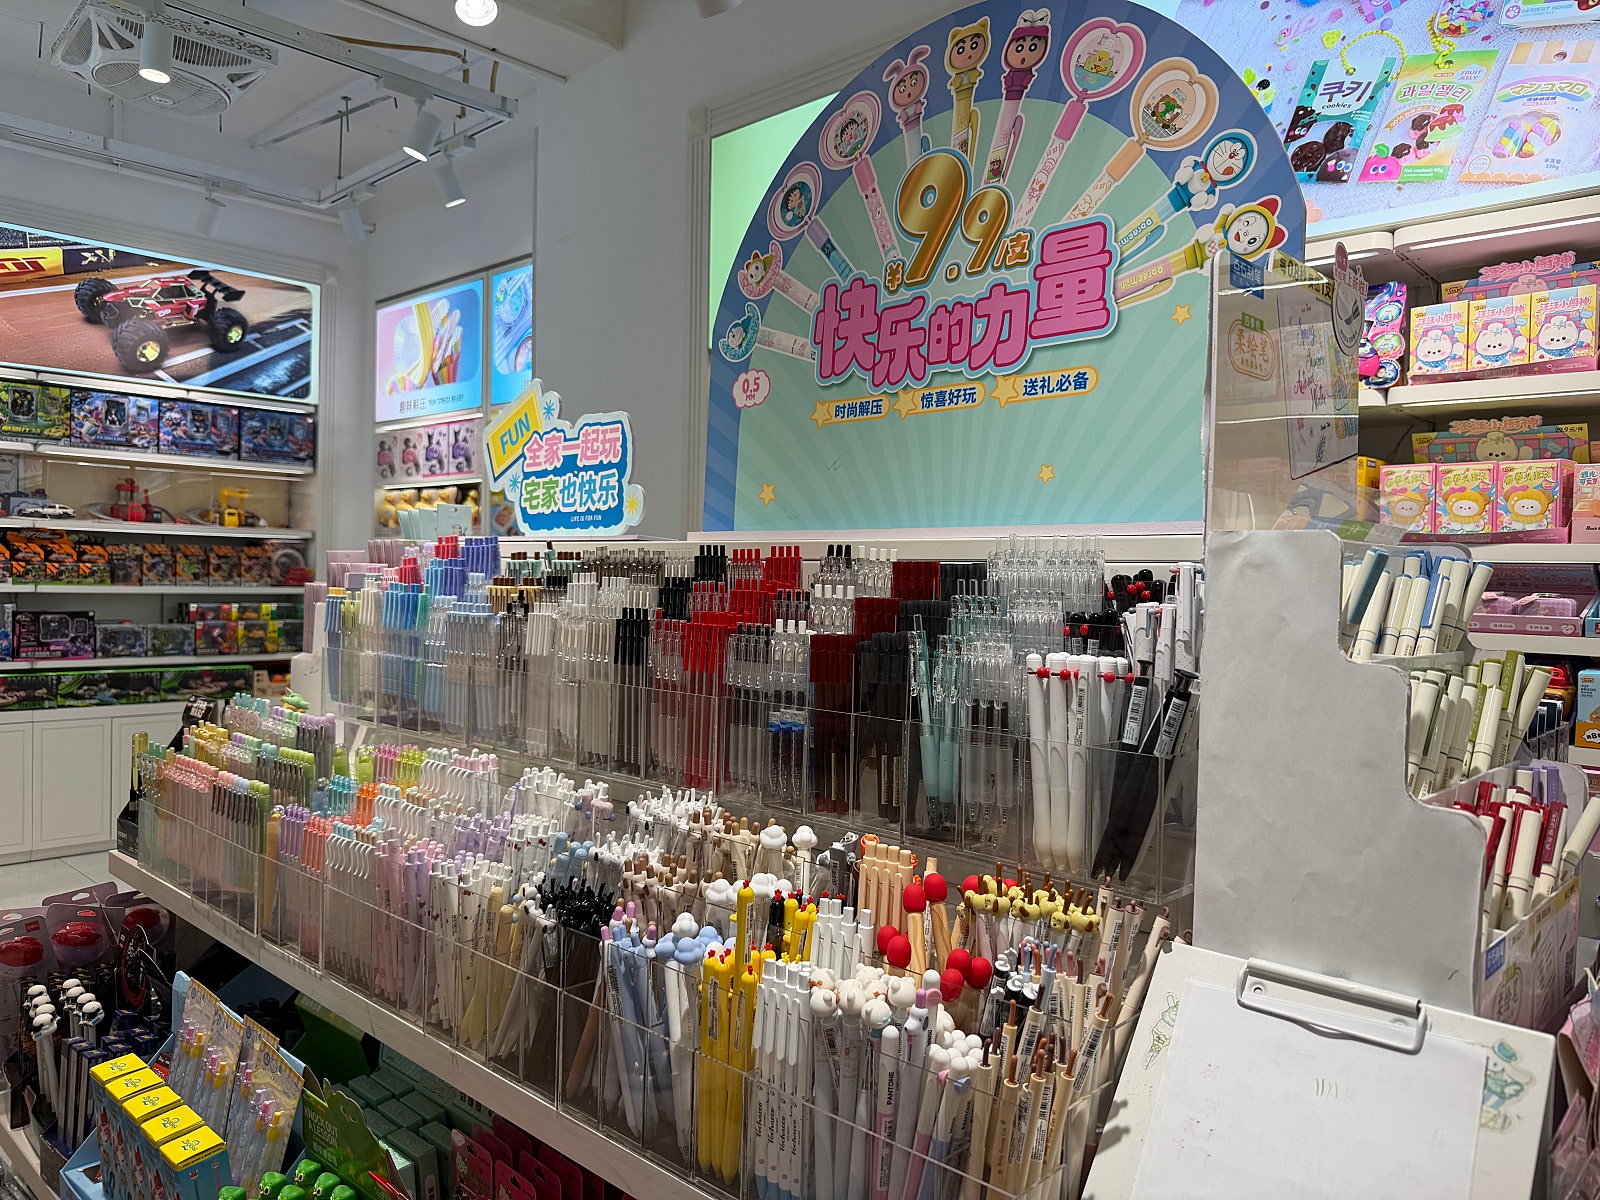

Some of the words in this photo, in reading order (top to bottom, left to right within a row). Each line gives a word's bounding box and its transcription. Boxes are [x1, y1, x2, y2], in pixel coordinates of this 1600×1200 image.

[1318, 80, 1373, 102] 쿠키
[1399, 82, 1473, 103] 과일젤리
[1321, 101, 1353, 110] cookies
[814, 220, 1114, 388] 快乐的力量
[1476, 304, 1526, 321] 汪汪小厨神
[1539, 296, 1592, 313] 汪汪小厨神
[742, 376, 761, 395] 0.5
[1022, 371, 1090, 397] 送礼必备
[745, 393, 756, 401] MM
[920, 386, 977, 410] 惊喜好玩
[834, 399, 884, 419] 时尚解压
[499, 411, 531, 456] FUN
[525, 426, 621, 469] 全家一起玩
[523, 472, 617, 510] 宅家也快乐
[886, 1071, 895, 1106] PANTONE
